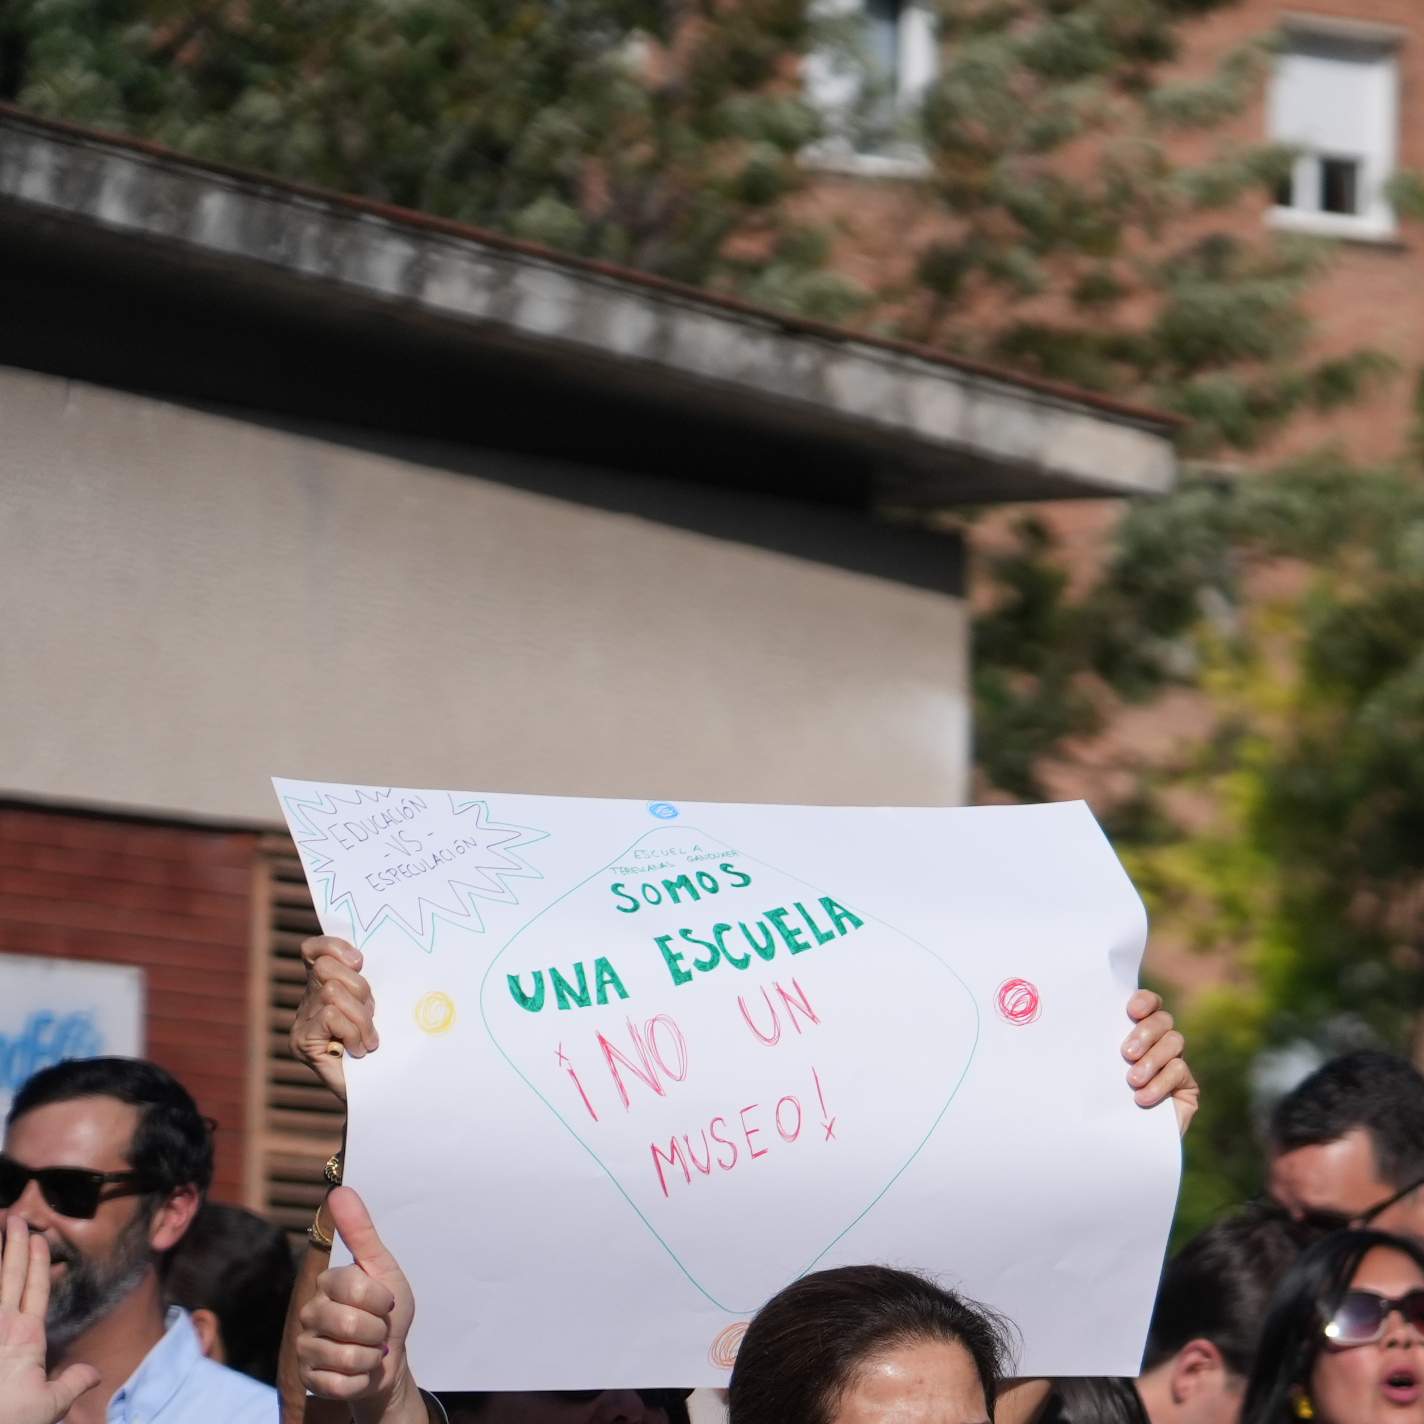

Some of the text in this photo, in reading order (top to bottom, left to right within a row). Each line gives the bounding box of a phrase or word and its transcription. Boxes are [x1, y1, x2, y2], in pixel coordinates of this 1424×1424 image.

[327, 795, 428, 850] EDUCACIÓN
[364, 836, 478, 892] ESPECULACIÓN
[610, 862, 753, 914] SOMOS
[506, 893, 864, 1013] UNA ESCUELA
[737, 976, 821, 1046] UN
[650, 1066, 837, 1198] MUSEO!
